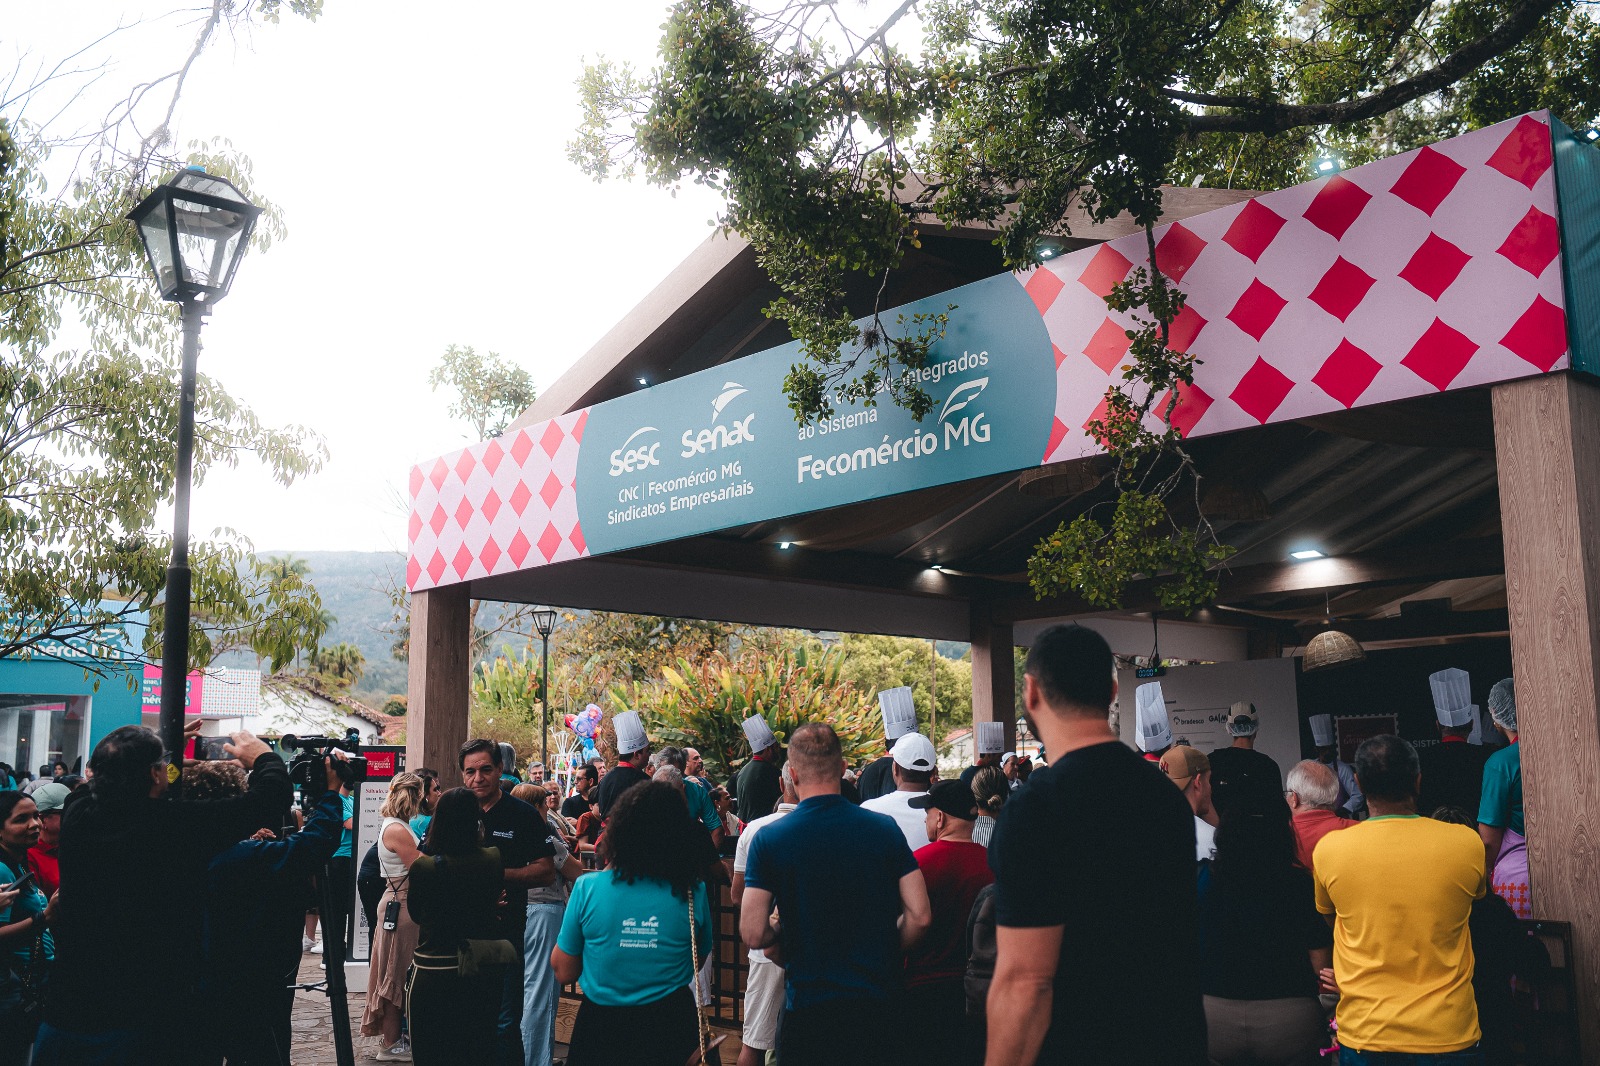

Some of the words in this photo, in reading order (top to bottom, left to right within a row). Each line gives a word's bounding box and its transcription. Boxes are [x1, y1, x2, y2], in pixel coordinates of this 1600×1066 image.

[609, 442, 661, 477] Sesc
[681, 413, 755, 458] Senac
[798, 426, 815, 441] ao
[818, 408, 878, 437] Sistema
[798, 428, 938, 484] Fecomércio
[944, 412, 991, 451] MG
[607, 501, 667, 525] Sindicatos
[670, 480, 754, 511] Empresariais
[618, 485, 639, 503] CNC
[648, 468, 717, 497] Fecomércio
[721, 460, 742, 480] MG
